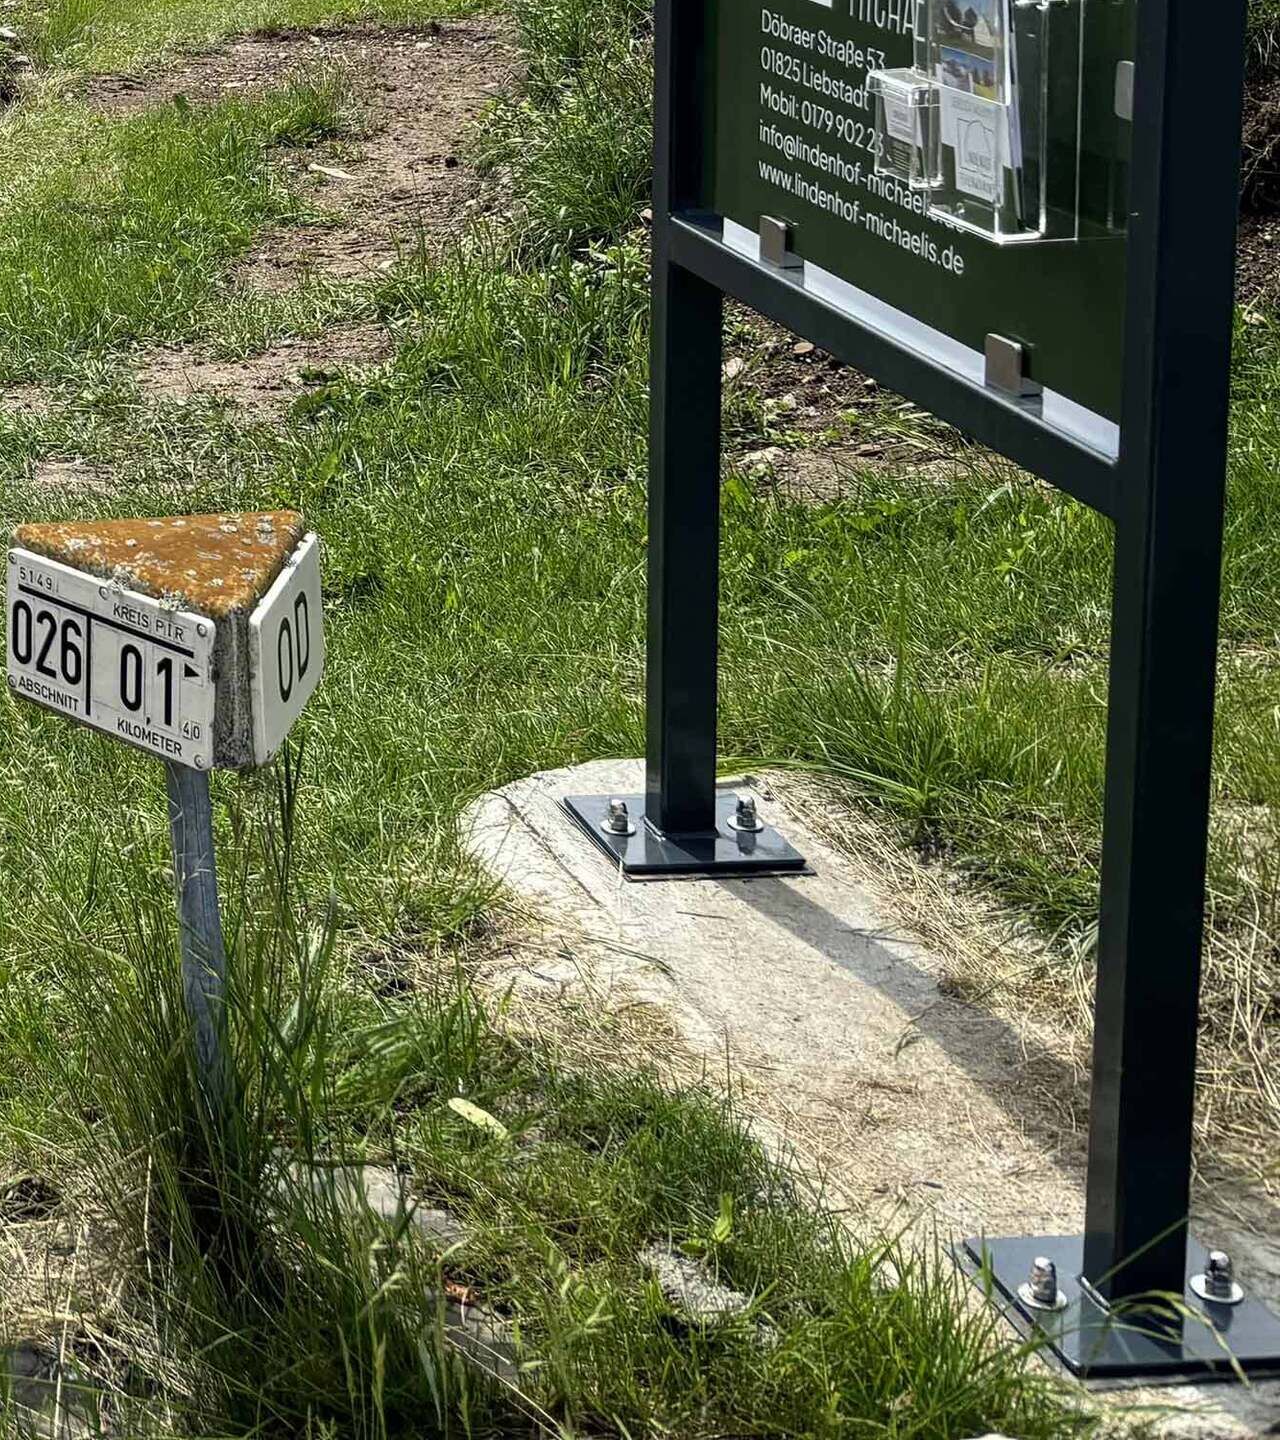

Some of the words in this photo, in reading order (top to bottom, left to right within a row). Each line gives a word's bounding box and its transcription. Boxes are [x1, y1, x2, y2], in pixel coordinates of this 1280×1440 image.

[761, 9, 817, 50] Döbraer
[817, 30, 864, 68] Straße
[866, 47, 886, 71] 53
[760, 46, 801, 83] 01825
[802, 61, 870, 111] Liebstadt
[760, 83, 800, 121] Mobil:
[801, 100, 834, 134] 0179
[836, 114, 865, 148] 902
[758, 160, 965, 276] www.lindenhof-michaelis.de
[11, 599, 83, 686] 026
[113, 602, 149, 629] KREIS
[155, 619, 184, 641] PIR
[277, 590, 310, 703] OD
[18, 675, 79, 712] ABSCHNITT
[117, 717, 183, 757] KILOMETER
[182, 721, 201, 740] 40
